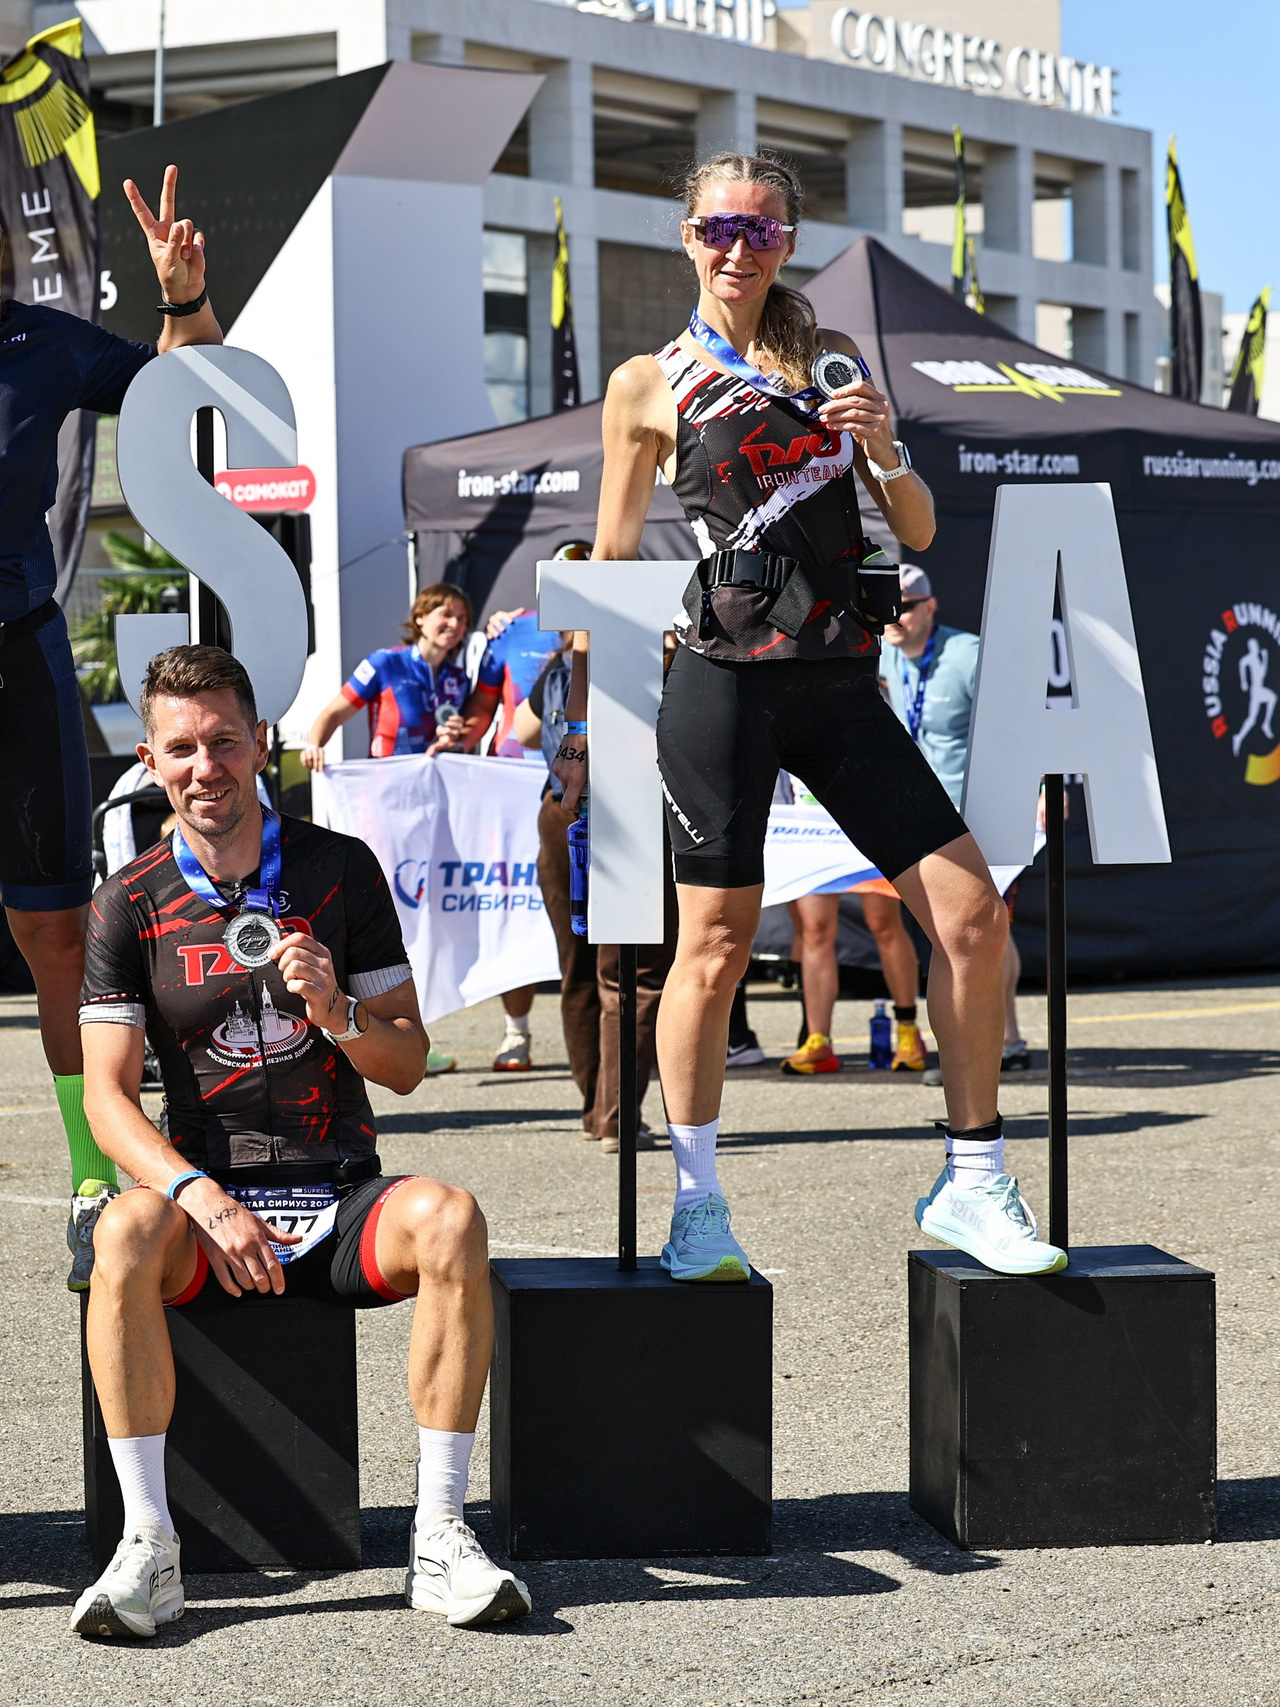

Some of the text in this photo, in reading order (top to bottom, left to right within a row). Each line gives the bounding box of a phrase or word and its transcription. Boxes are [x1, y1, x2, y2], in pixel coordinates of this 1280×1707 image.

[830, 6, 1004, 90] CONGRESS
[958, 444, 1081, 475] iron-star.com
[1143, 449, 1280, 487] russiarunning.co
[457, 469, 580, 498] iron-star.com
[439, 861, 540, 887] ТРАН
[441, 893, 544, 912] СИБИРЬ
[205, 1048, 251, 1068] МОСКОВСКАЯ
[295, 1038, 315, 1059] ДОРОГА
[268, 1200, 308, 1208] СИРИУС
[265, 1214, 319, 1235] 477
